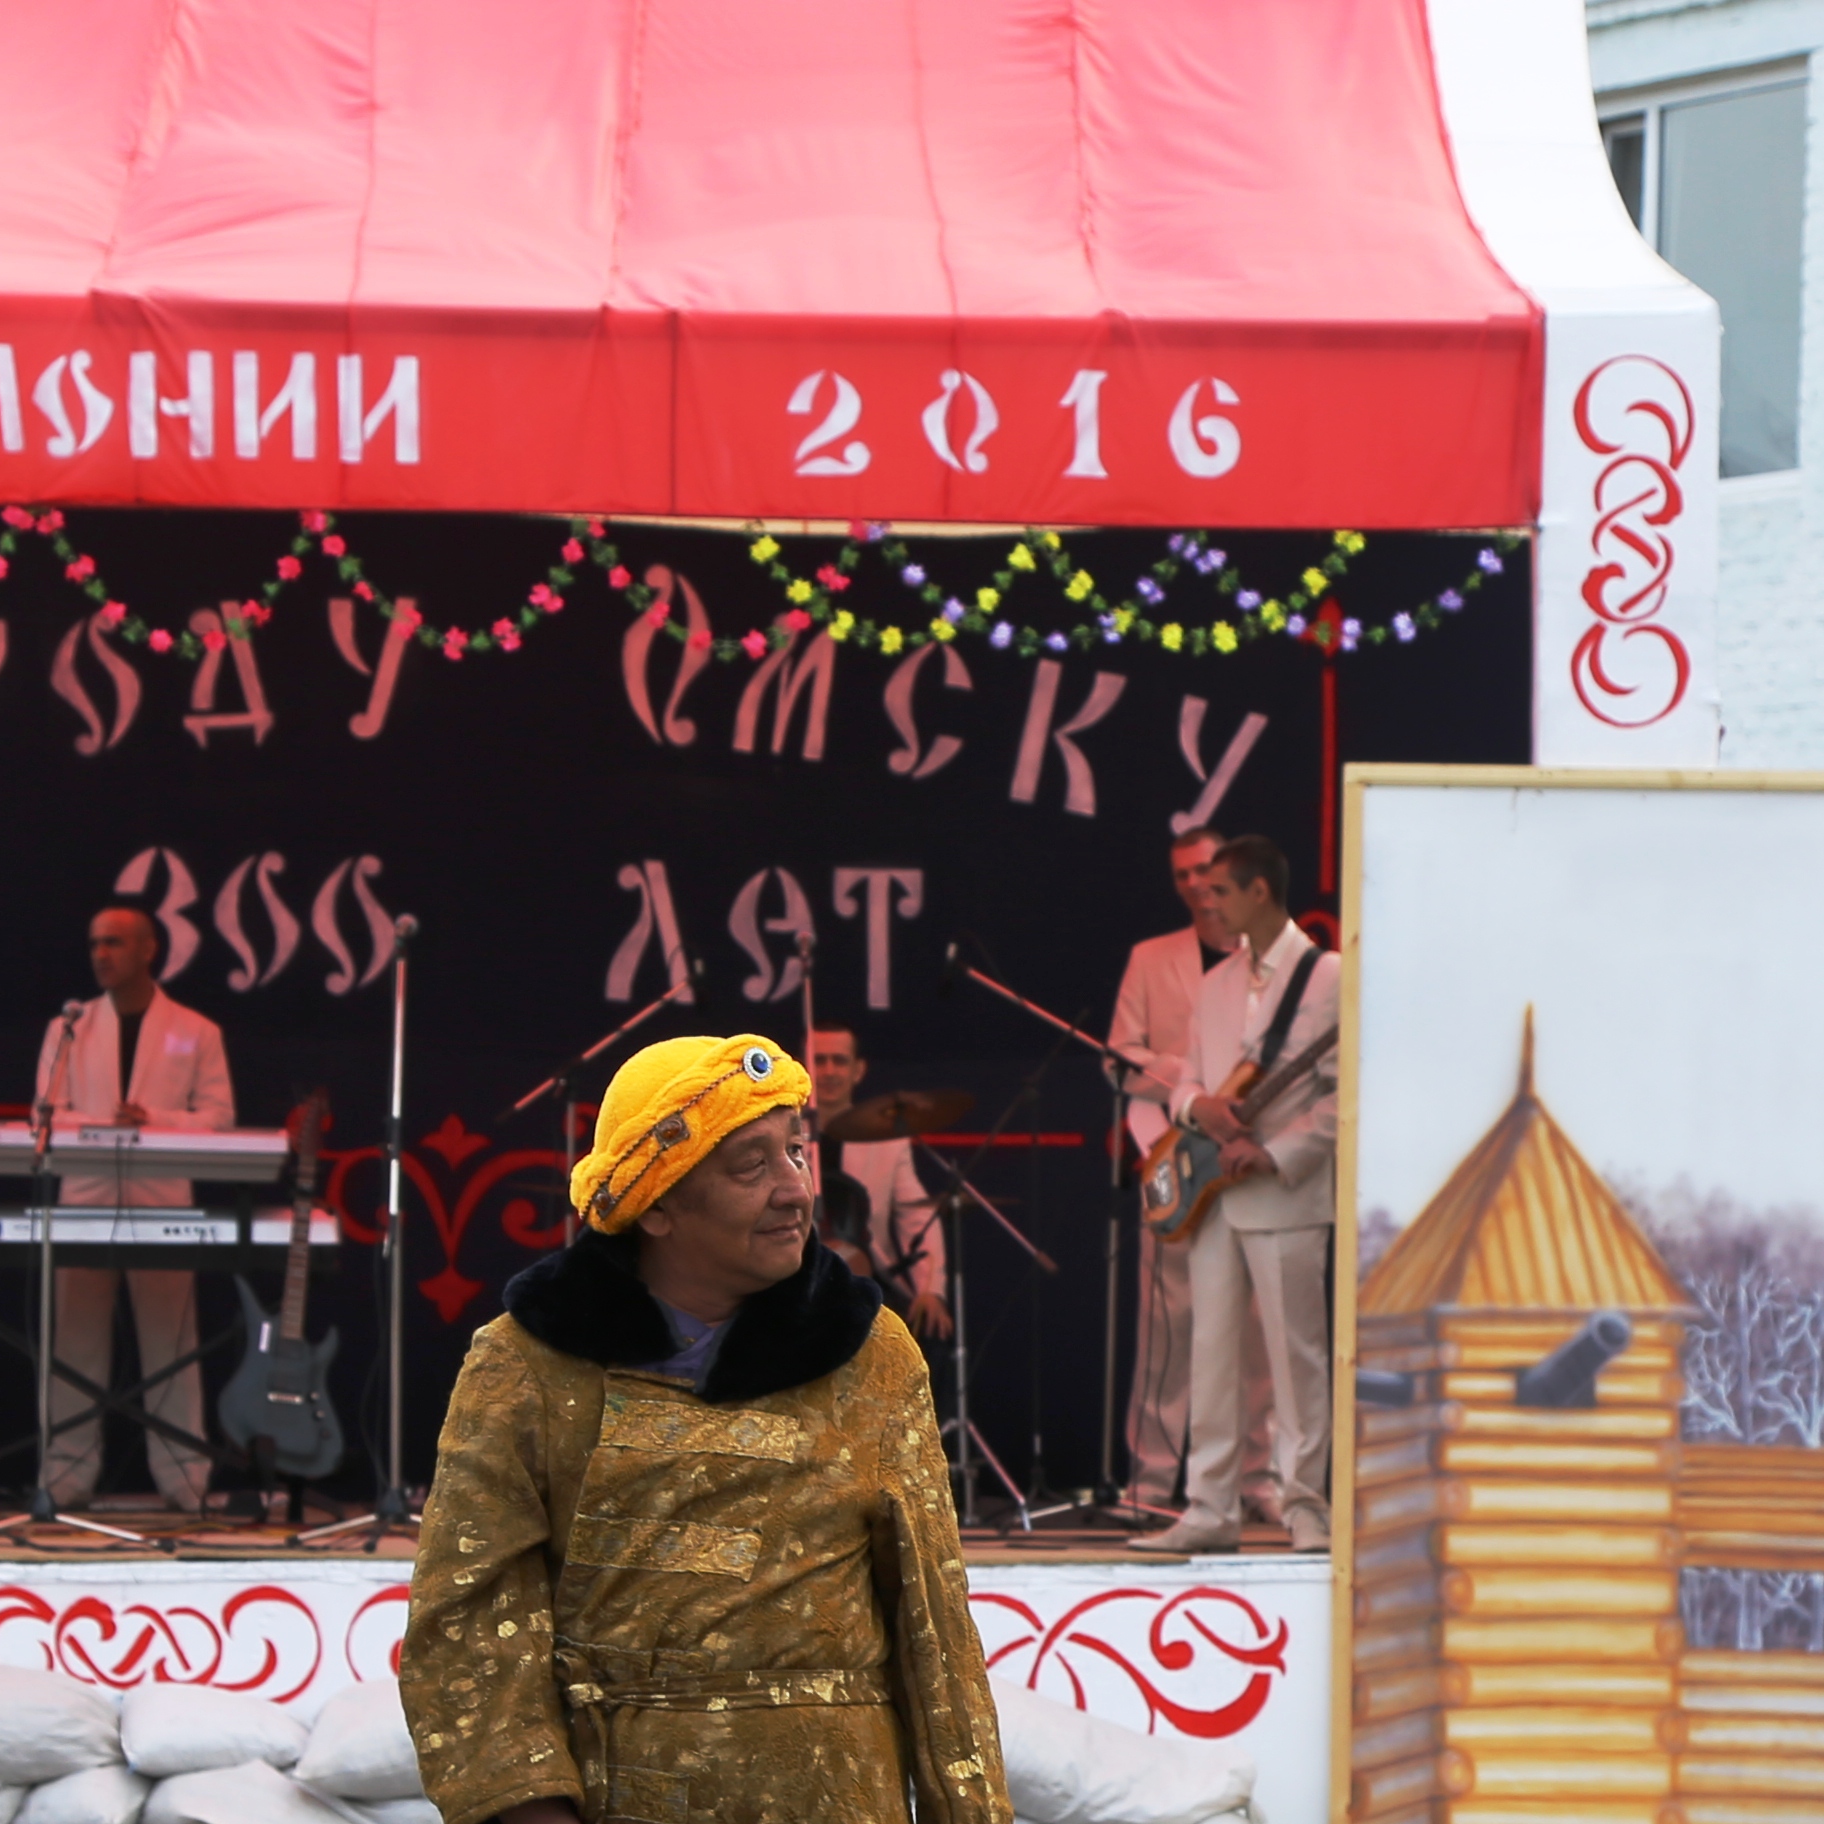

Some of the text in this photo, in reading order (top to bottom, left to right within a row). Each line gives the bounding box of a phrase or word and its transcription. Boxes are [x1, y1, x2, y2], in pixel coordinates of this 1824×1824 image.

[786, 369, 1242, 479] 2016
[622, 564, 1269, 836] ОМСКУ
[114, 847, 924, 1008] 300 ЛЕТ
